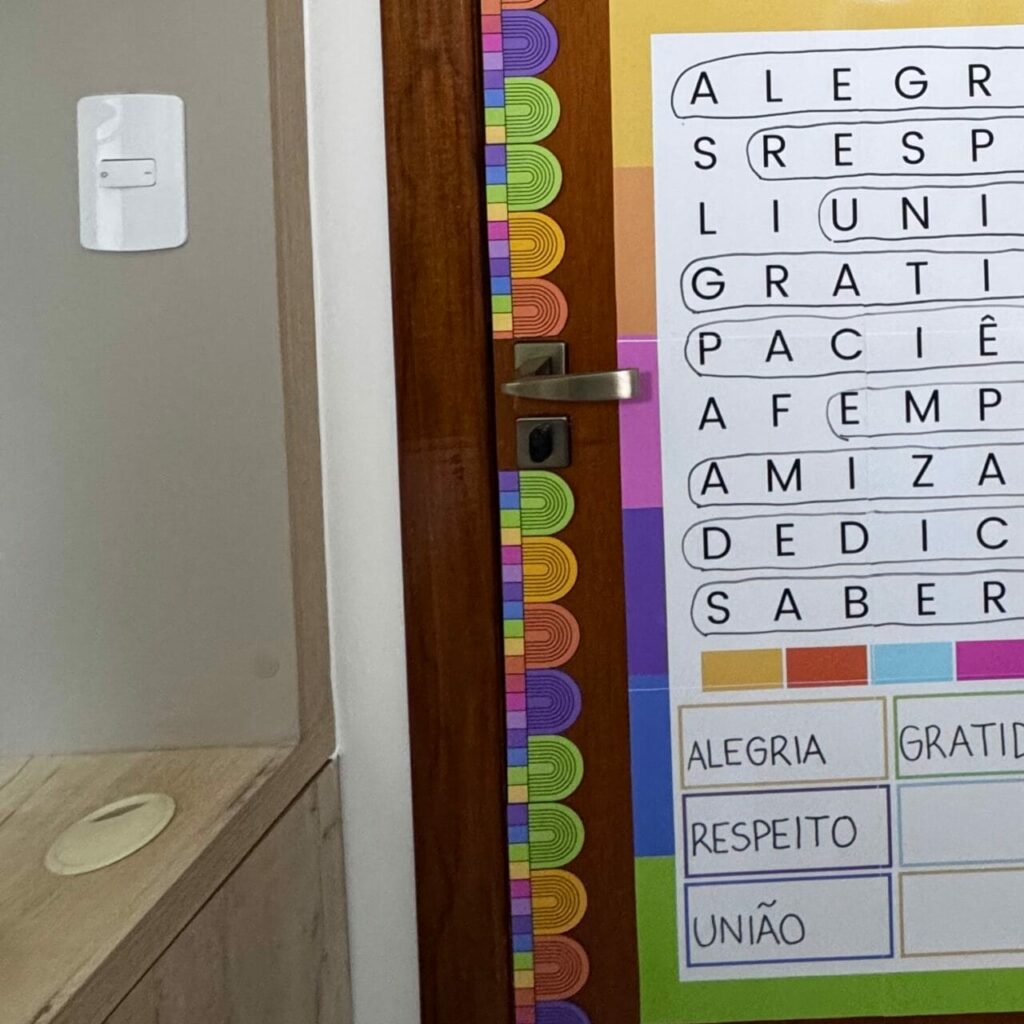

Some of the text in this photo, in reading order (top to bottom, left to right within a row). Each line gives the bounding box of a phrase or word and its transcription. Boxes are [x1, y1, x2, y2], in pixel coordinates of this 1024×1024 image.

[687, 734, 826, 771] ALEGRIA
[691, 815, 857, 856] RESPEITO
[693, 899, 805, 947] UNIÃO
